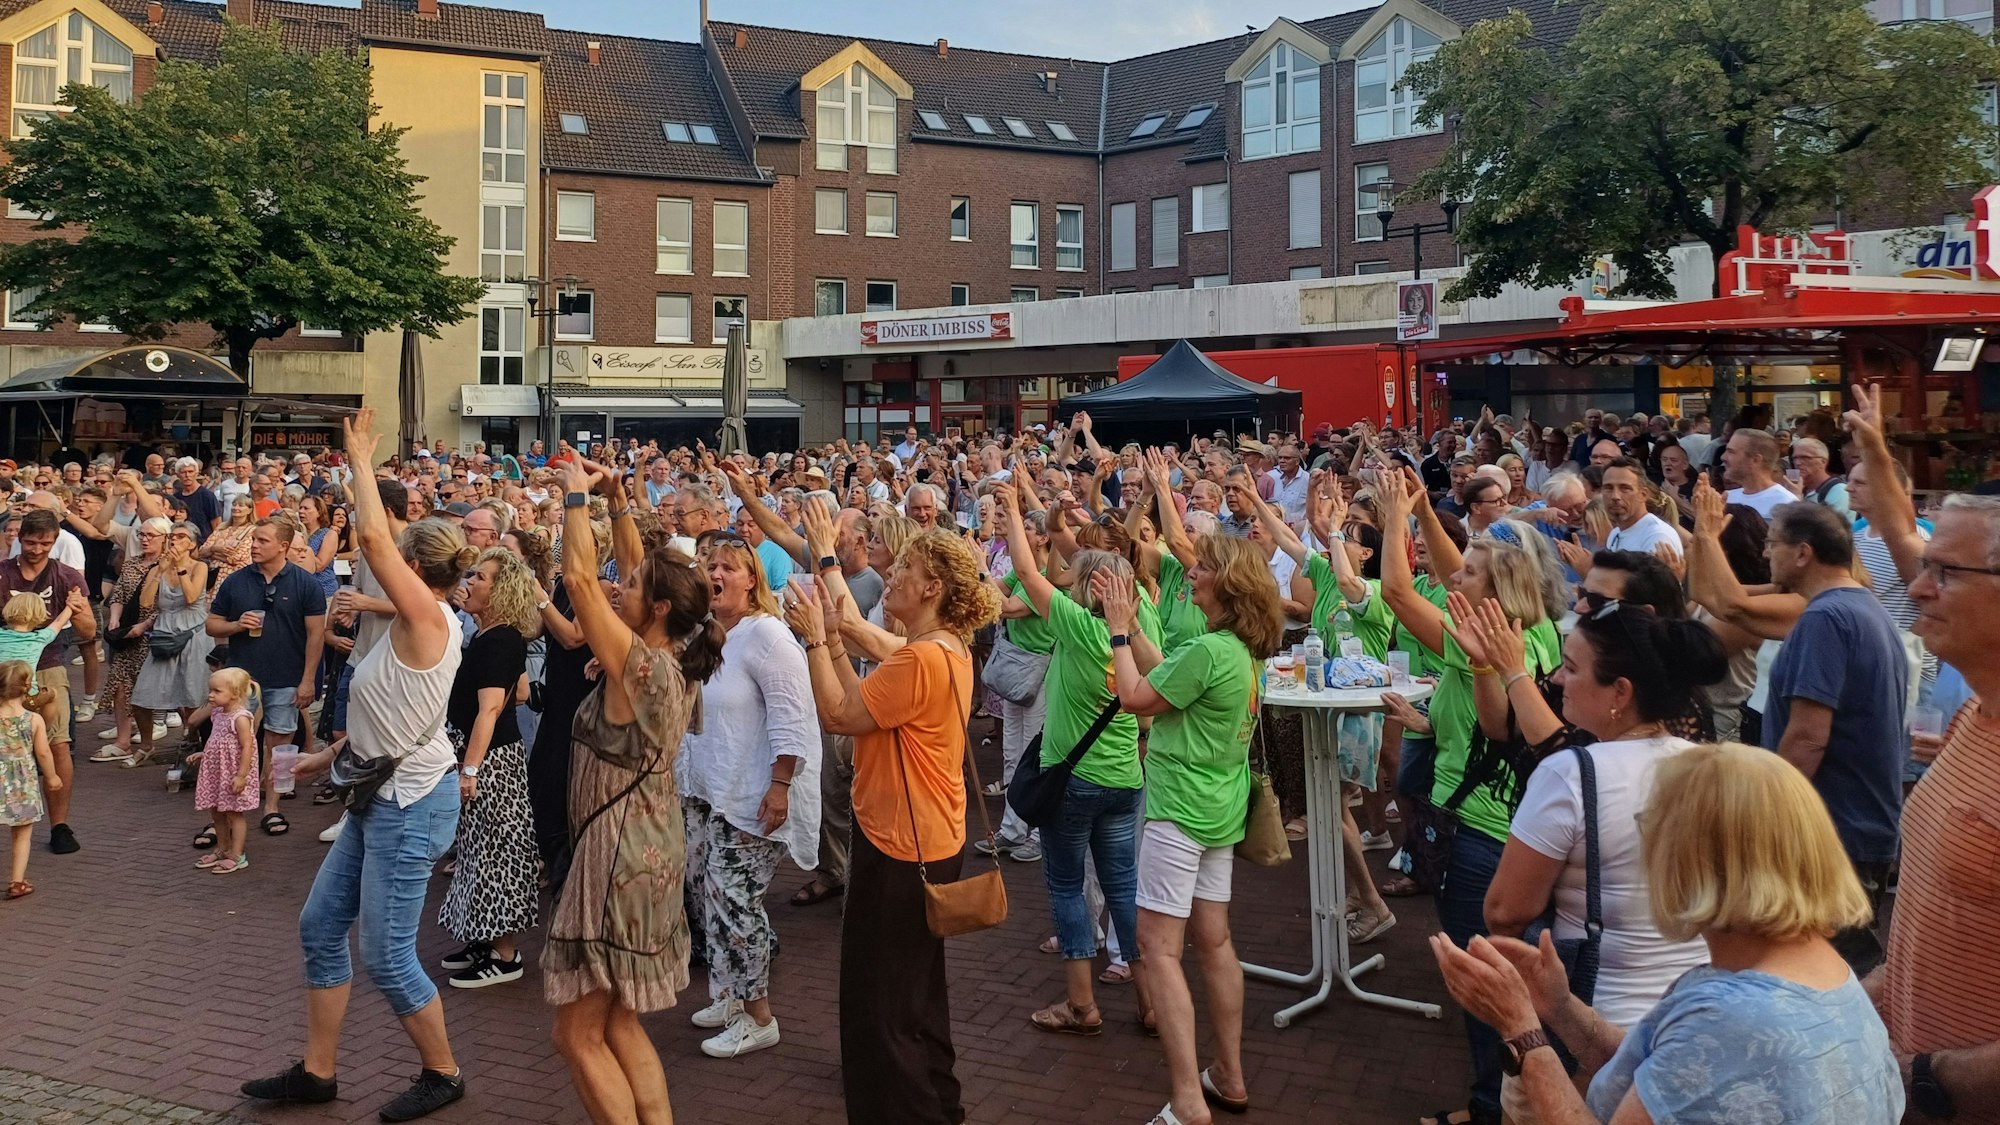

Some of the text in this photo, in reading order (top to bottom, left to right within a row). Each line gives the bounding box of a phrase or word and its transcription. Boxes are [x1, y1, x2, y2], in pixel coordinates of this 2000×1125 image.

[882, 319, 985, 339] DÖNER IMBISS
[664, 354, 698, 370] San
[466, 405, 473, 415] 9
[254, 430, 331, 445] DIE MÖHRE
